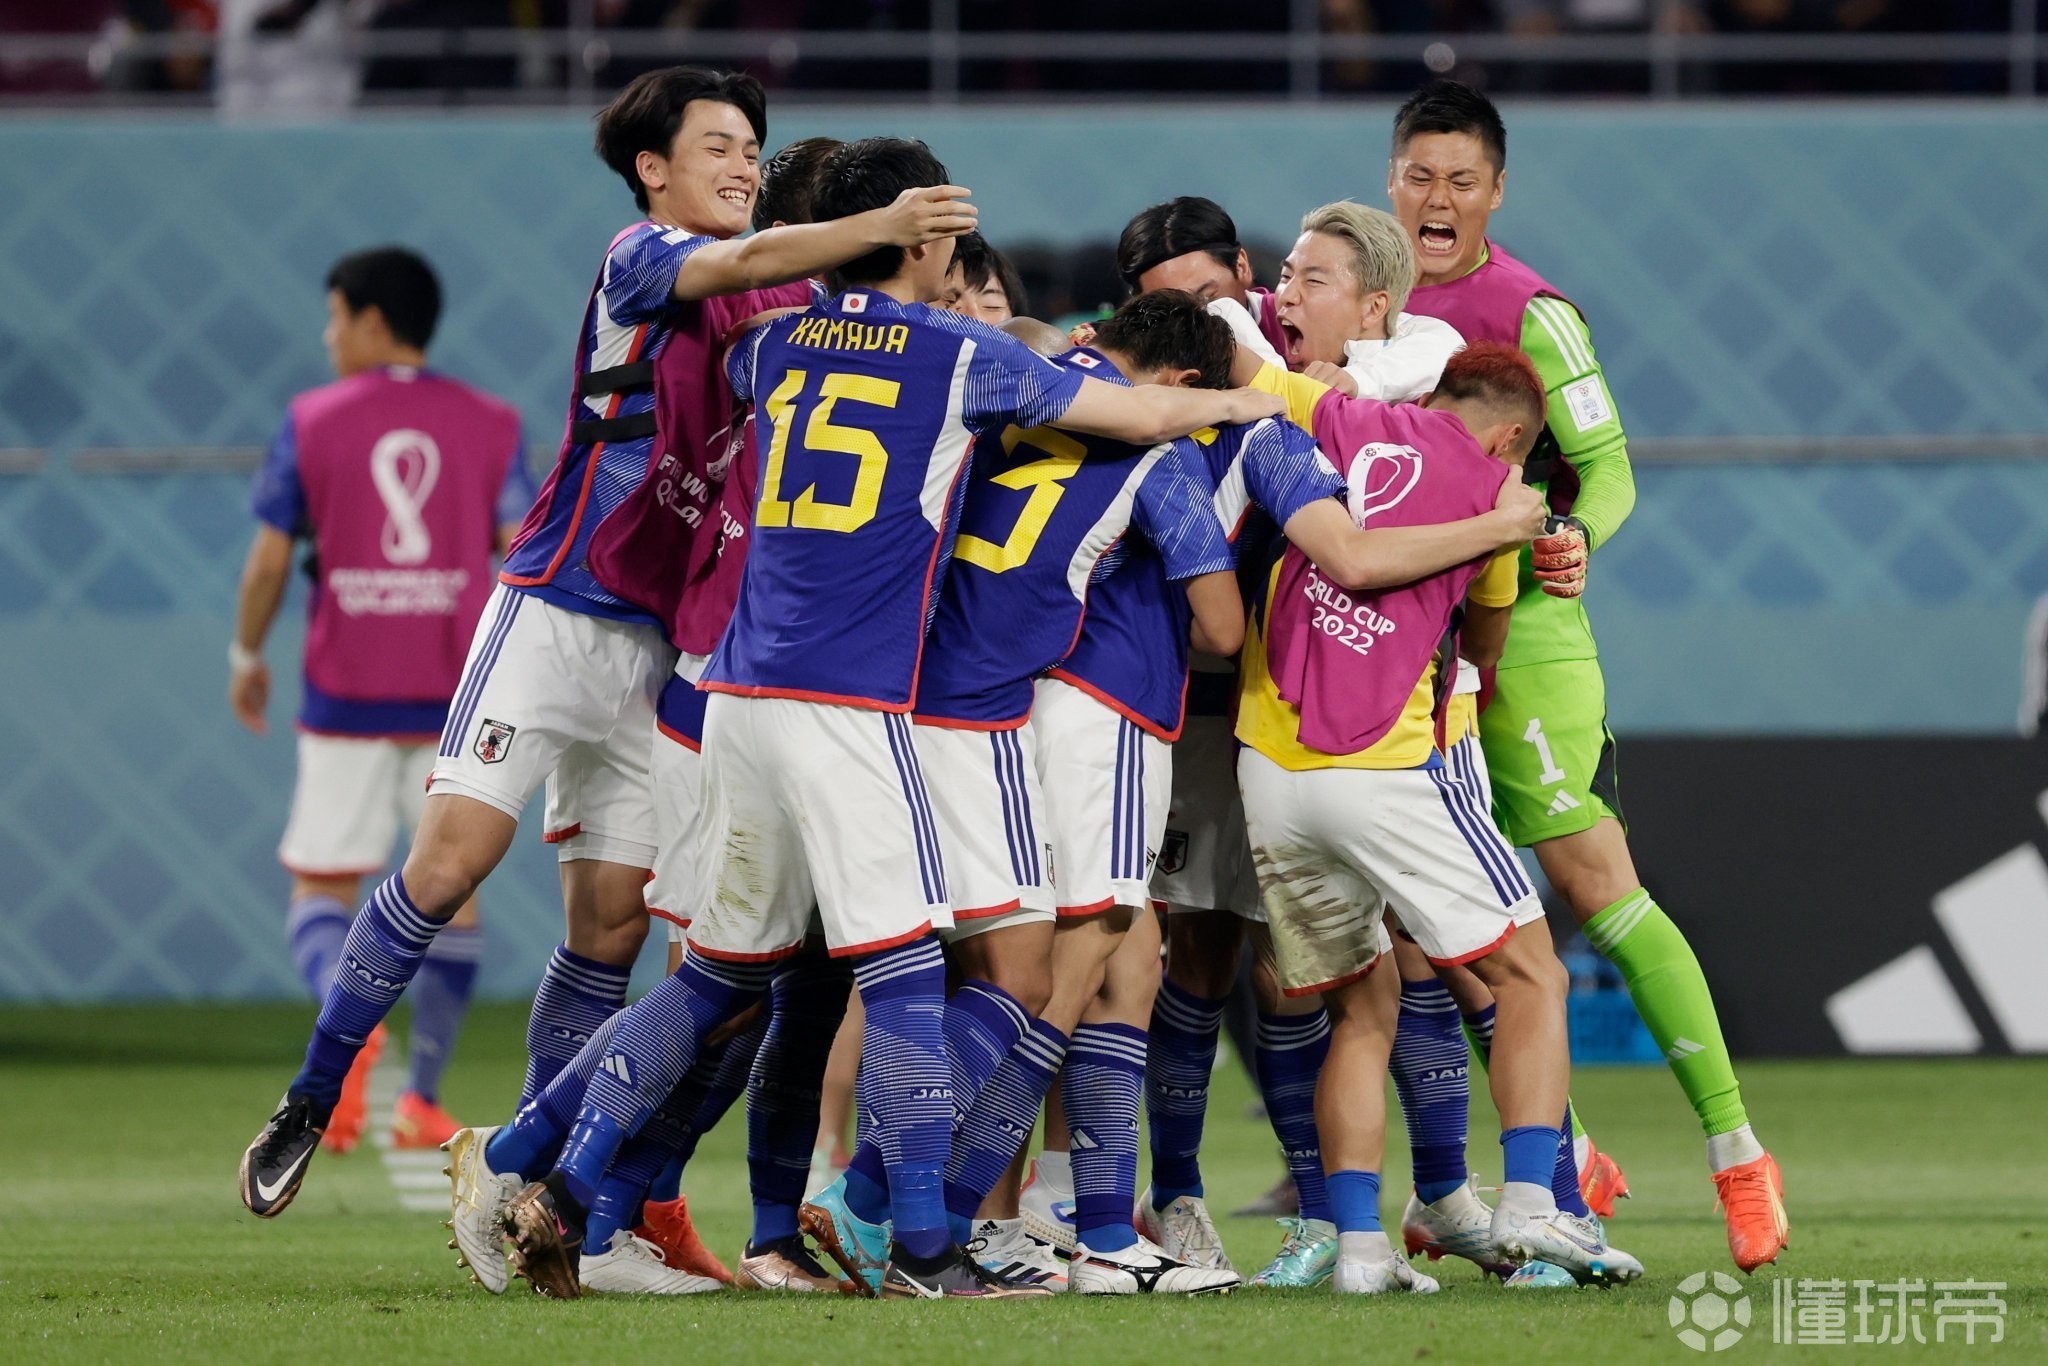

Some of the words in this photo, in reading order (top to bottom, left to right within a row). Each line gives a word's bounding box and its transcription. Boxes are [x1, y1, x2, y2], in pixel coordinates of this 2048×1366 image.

[786, 317, 909, 354] KAMADA
[755, 369, 901, 534] 15
[951, 423, 1088, 574] 3
[1311, 605, 1374, 656] 2022
[1353, 605, 1396, 636] CUP
[1523, 717, 1566, 786] 1
[1422, 1065, 1469, 1082] JAP
[914, 1088, 953, 1099] JAP
[1157, 1085, 1209, 1099] JAP
[655, 1111, 692, 1134] JAP
[977, 1227, 1004, 1238] adidas
